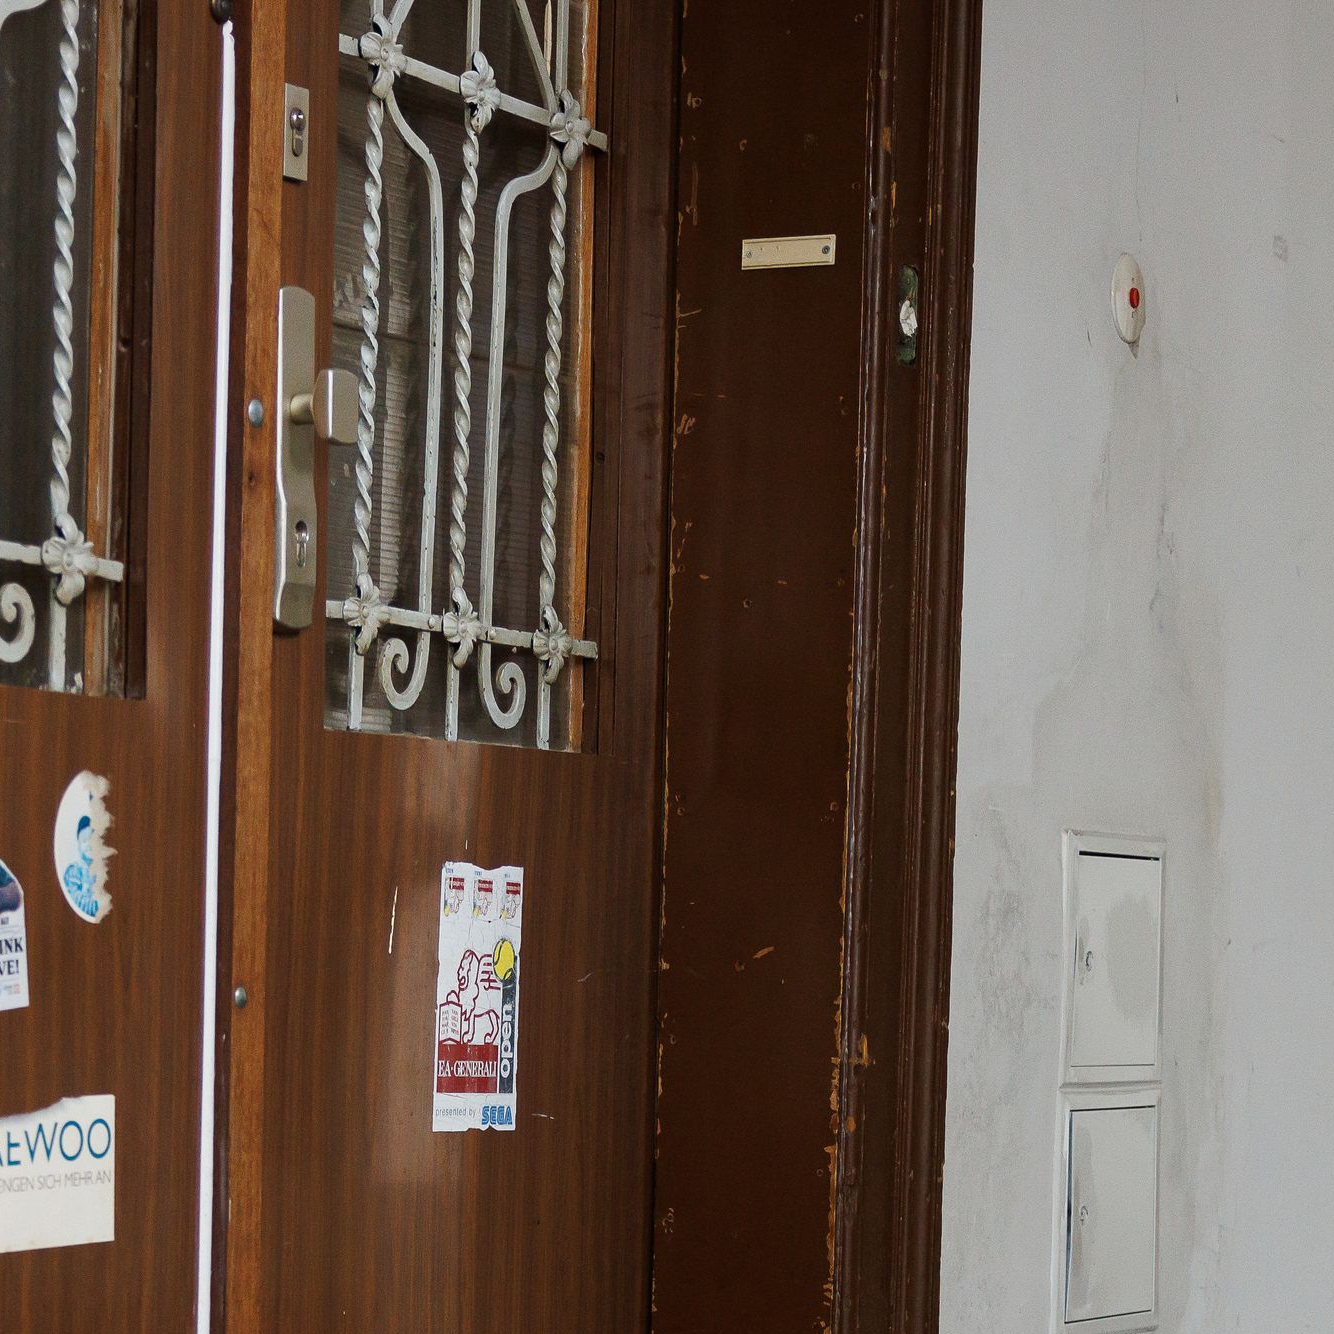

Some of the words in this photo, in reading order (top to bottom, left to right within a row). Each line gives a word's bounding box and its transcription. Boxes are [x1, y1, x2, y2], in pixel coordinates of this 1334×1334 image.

[500, 1003, 513, 1079] open
[435, 1105, 467, 1117] presented
[468, 1106, 477, 1117] by
[481, 1105, 513, 1126] SEGA
[37, 1173, 61, 1191] SICH
[64, 1171, 93, 1188] MEHR
[95, 1170, 112, 1185] AN
